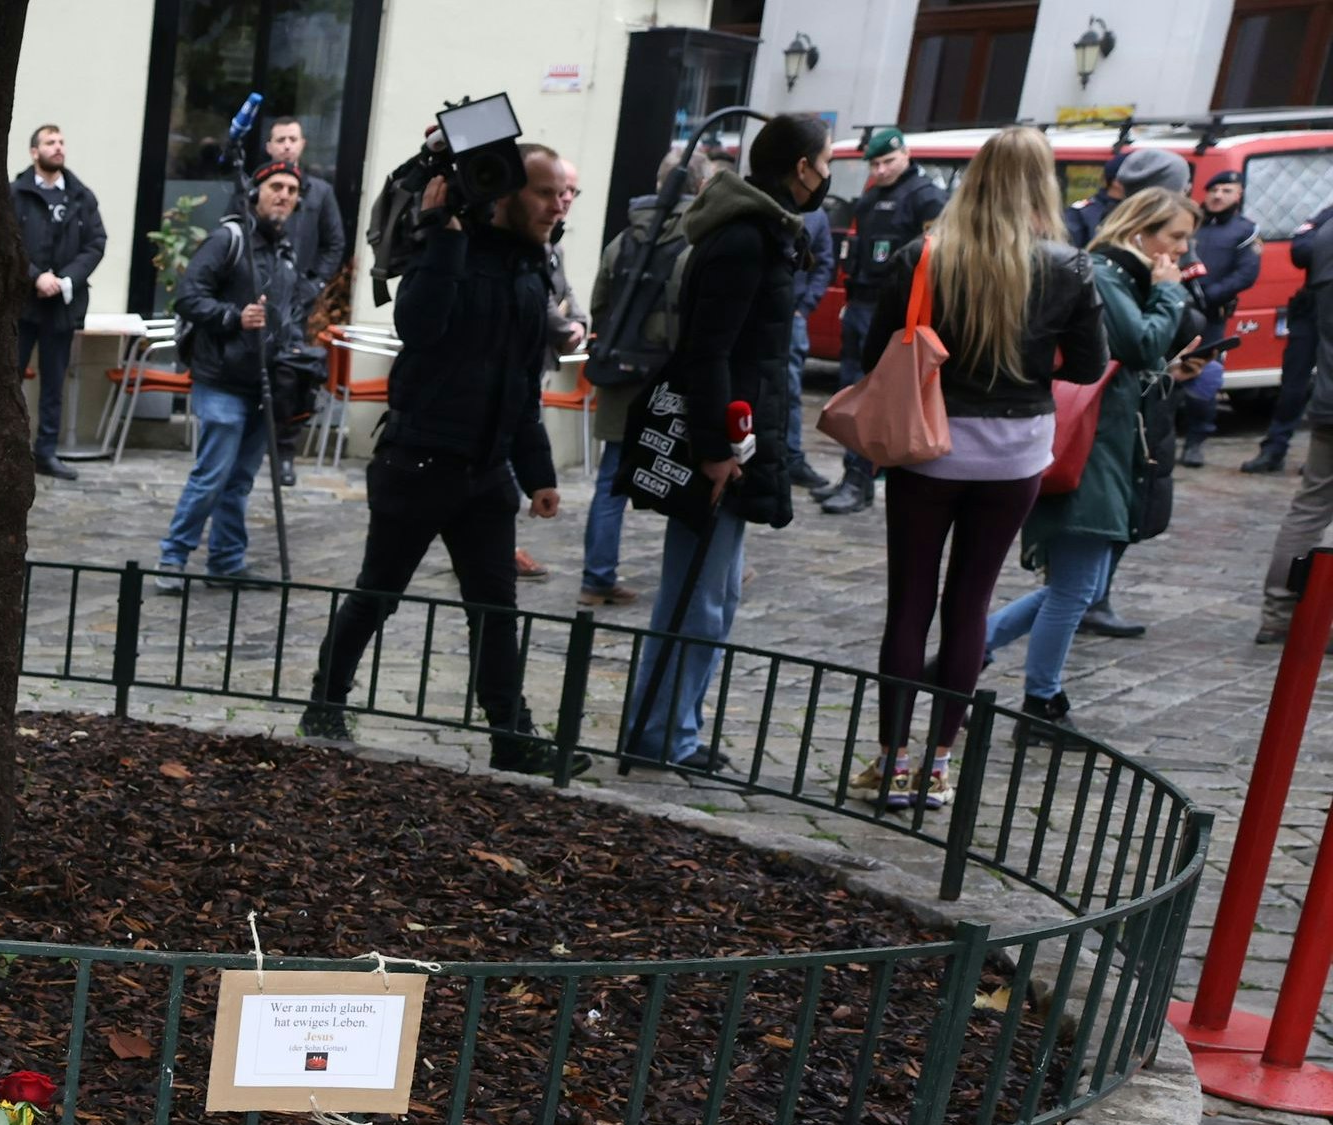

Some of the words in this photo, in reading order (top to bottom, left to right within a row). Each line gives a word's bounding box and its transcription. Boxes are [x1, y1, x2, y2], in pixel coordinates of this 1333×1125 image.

[271, 1002, 293, 1013] Wer
[295, 1004, 308, 1013] an
[311, 1002, 337, 1013] mich
[340, 1003, 376, 1015] glaubt,
[274, 1017, 290, 1027] hat
[293, 1018, 329, 1029] ewiges
[332, 1017, 368, 1028] Leben.
[304, 1032, 334, 1041] Jesus
